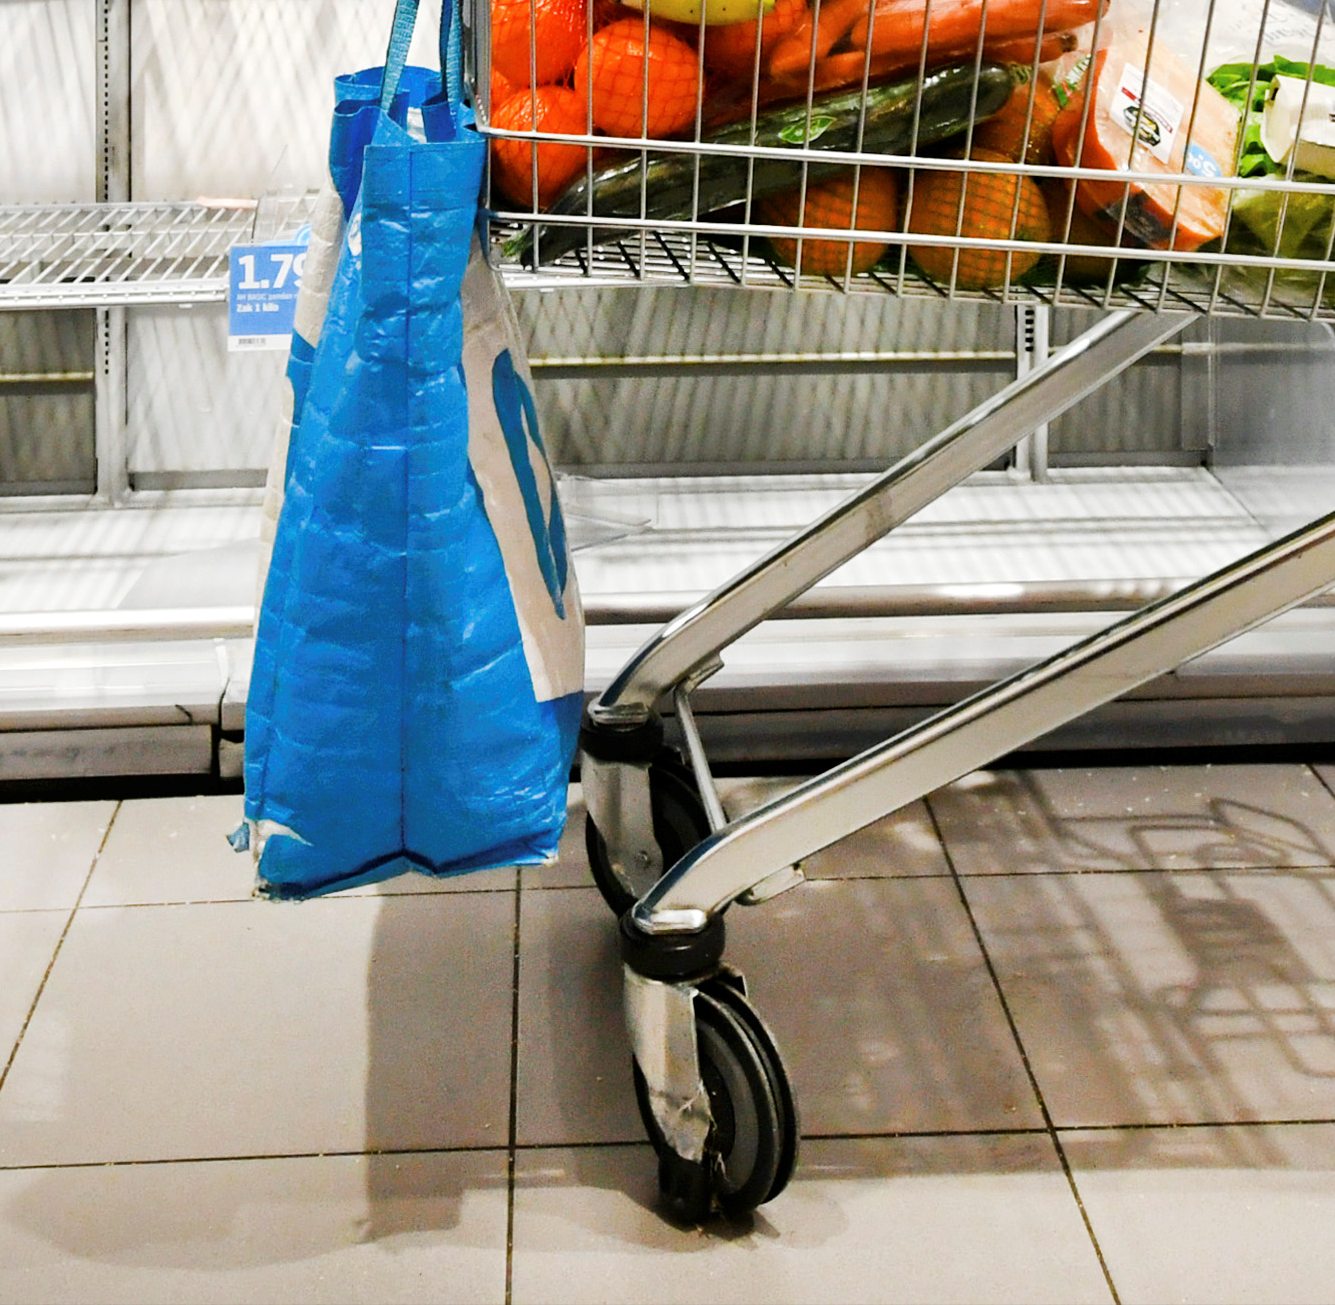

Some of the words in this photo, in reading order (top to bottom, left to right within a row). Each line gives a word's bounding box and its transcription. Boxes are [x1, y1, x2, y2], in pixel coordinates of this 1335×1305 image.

[236, 302, 253, 312] Zak
[255, 303, 261, 312] 1
[262, 302, 279, 312] kilo
